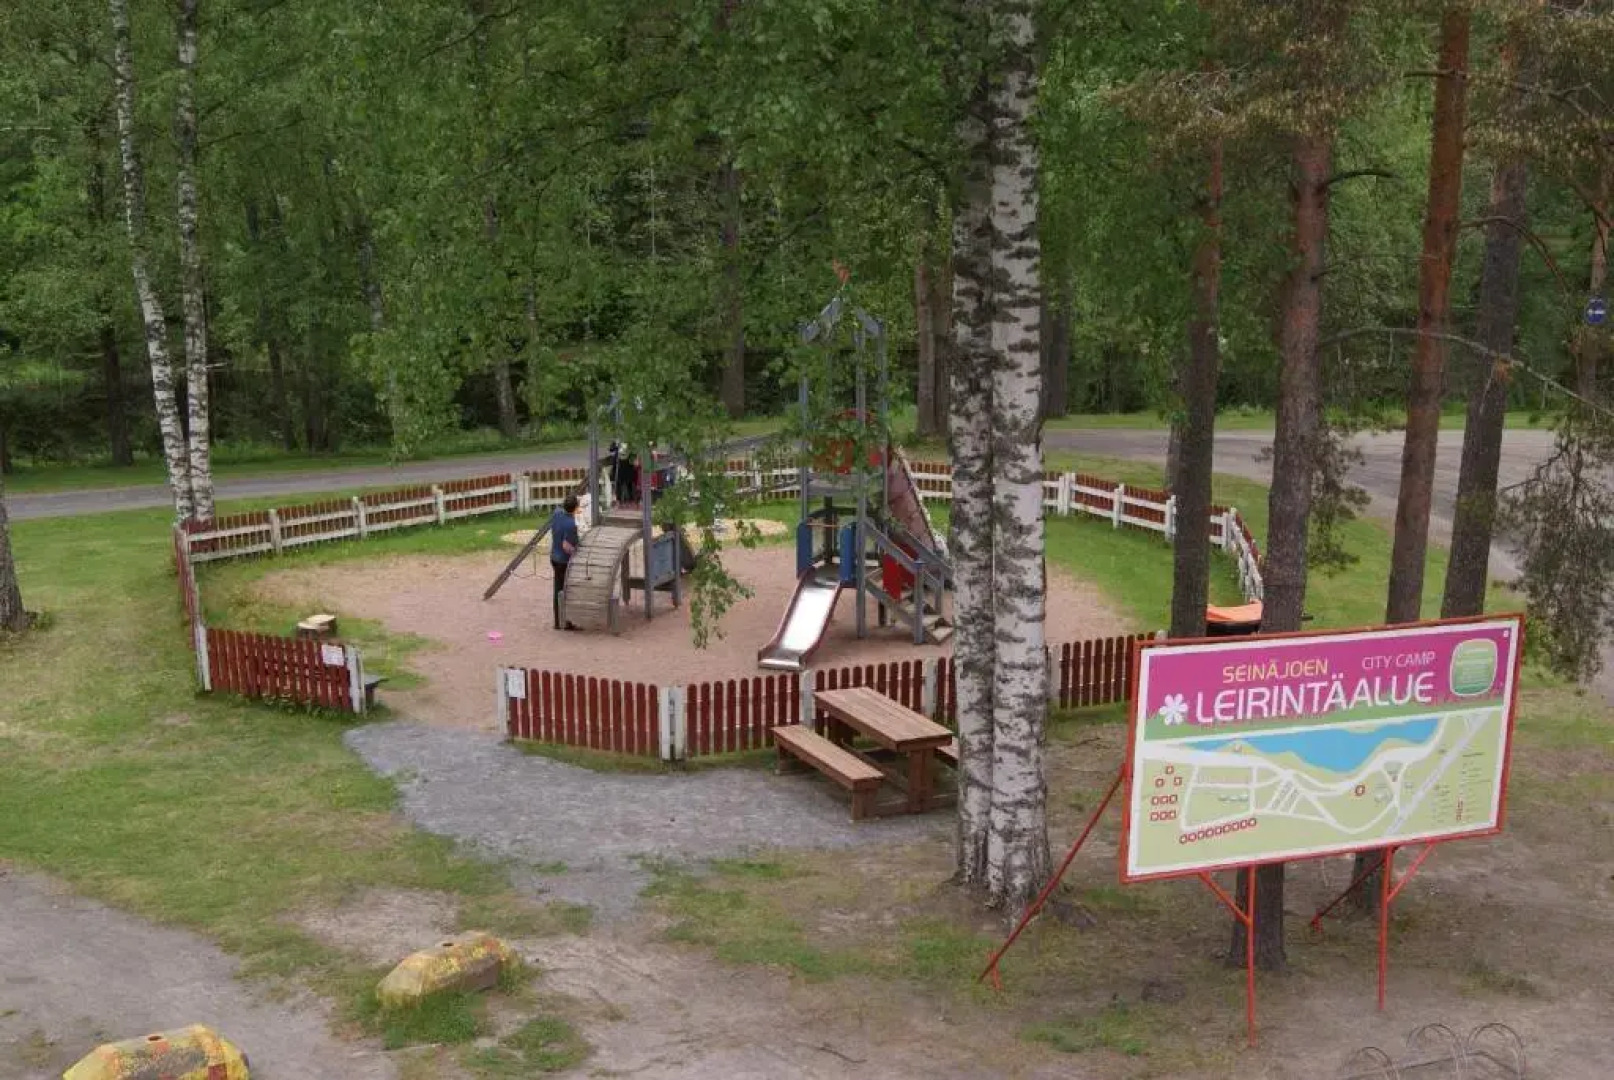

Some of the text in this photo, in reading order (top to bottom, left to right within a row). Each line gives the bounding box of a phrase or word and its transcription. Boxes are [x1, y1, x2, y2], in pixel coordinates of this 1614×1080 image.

[1223, 658, 1329, 684] SEINÄJOEN
[1362, 651, 1437, 670] CITY CAMP
[1195, 672, 1435, 724] LEIRINTÄALUE
